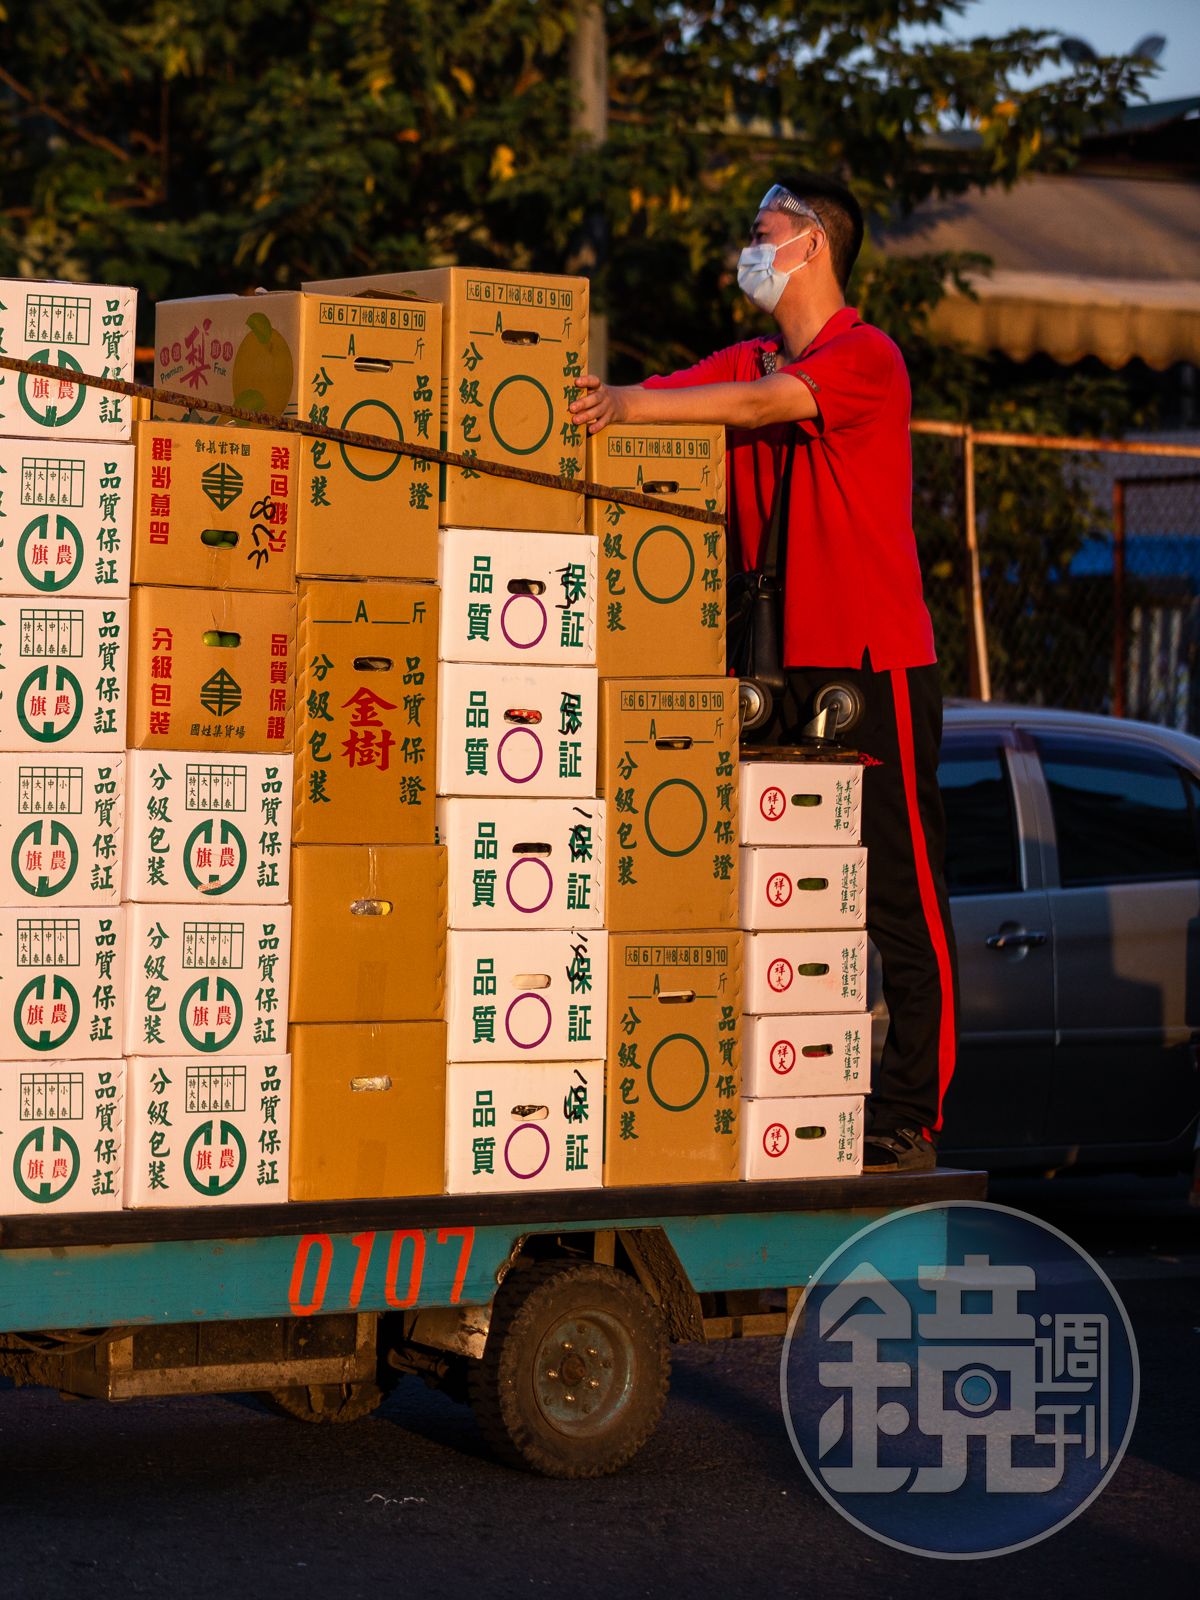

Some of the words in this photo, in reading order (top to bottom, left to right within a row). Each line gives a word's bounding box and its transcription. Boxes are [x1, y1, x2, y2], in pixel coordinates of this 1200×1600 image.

[338, 309, 343, 321] 6
[352, 310, 357, 321] 7
[391, 312, 396, 325] 8
[404, 313, 409, 326] 9
[414, 314, 423, 327] 10
[348, 334, 355, 356] A
[485, 286, 490, 298] 6
[498, 287, 503, 299] 7
[537, 291, 542, 304] 8
[550, 292, 556, 305] 9
[561, 294, 570, 306] 10
[496, 311, 502, 332] A
[180, 318, 212, 389] 梨
[309, 366, 334, 508] 分級包裝
[409, 374, 433, 510] 品質保證
[459, 342, 484, 480] 分級包裝
[626, 441, 631, 453] 6
[639, 441, 643, 453] 7
[676, 442, 681, 454] 8
[689, 442, 693, 454] 9
[700, 442, 708, 455] 10
[95, 462, 121, 584] 品質保証
[150, 438, 171, 544] 品質保證
[268, 447, 290, 552] 分級包裝
[637, 465, 643, 486] A
[356, 600, 368, 622] A
[413, 602, 426, 623] 斤
[467, 556, 493, 641] 品質
[603, 503, 626, 632] 分級包裝
[94, 611, 120, 734] 品質保証
[150, 628, 172, 734] 分級包裝
[267, 634, 287, 739] 品質保證
[639, 695, 644, 707] 6
[651, 695, 656, 707] 7
[690, 695, 694, 707] 8
[702, 695, 707, 707] 9
[712, 695, 721, 707] 10
[190, 724, 246, 738] 國姓集貨場
[307, 655, 334, 803] 分級包裝
[341, 687, 397, 771] 金樹
[400, 656, 425, 805] 品質保證
[465, 691, 488, 775] 品質
[650, 719, 656, 739] A
[91, 768, 116, 890] 品質保証
[147, 764, 172, 885] 分級包裝
[257, 767, 282, 887] 品質保証
[472, 822, 497, 907] 品質
[615, 752, 638, 884] 分級包裝
[714, 752, 734, 880] 品質保證
[90, 919, 116, 1041] 品質保証
[144, 922, 169, 1043] 分級包裝
[254, 924, 279, 1043] 品質保証
[473, 959, 496, 1043] 品質
[643, 950, 648, 962] 6
[656, 951, 660, 962] 7
[694, 950, 699, 962] 8
[706, 950, 711, 962] 9
[716, 950, 725, 962] 10
[653, 974, 660, 994] A
[618, 1007, 640, 1139] 分級包裝
[715, 1006, 736, 1134] 品質保證
[92, 1072, 117, 1195] 品質保証
[148, 1068, 172, 1189] 分級包裝
[257, 1066, 281, 1185] 品質保証
[472, 1090, 495, 1175] 品質
[288, 1227, 475, 1316] 0107
